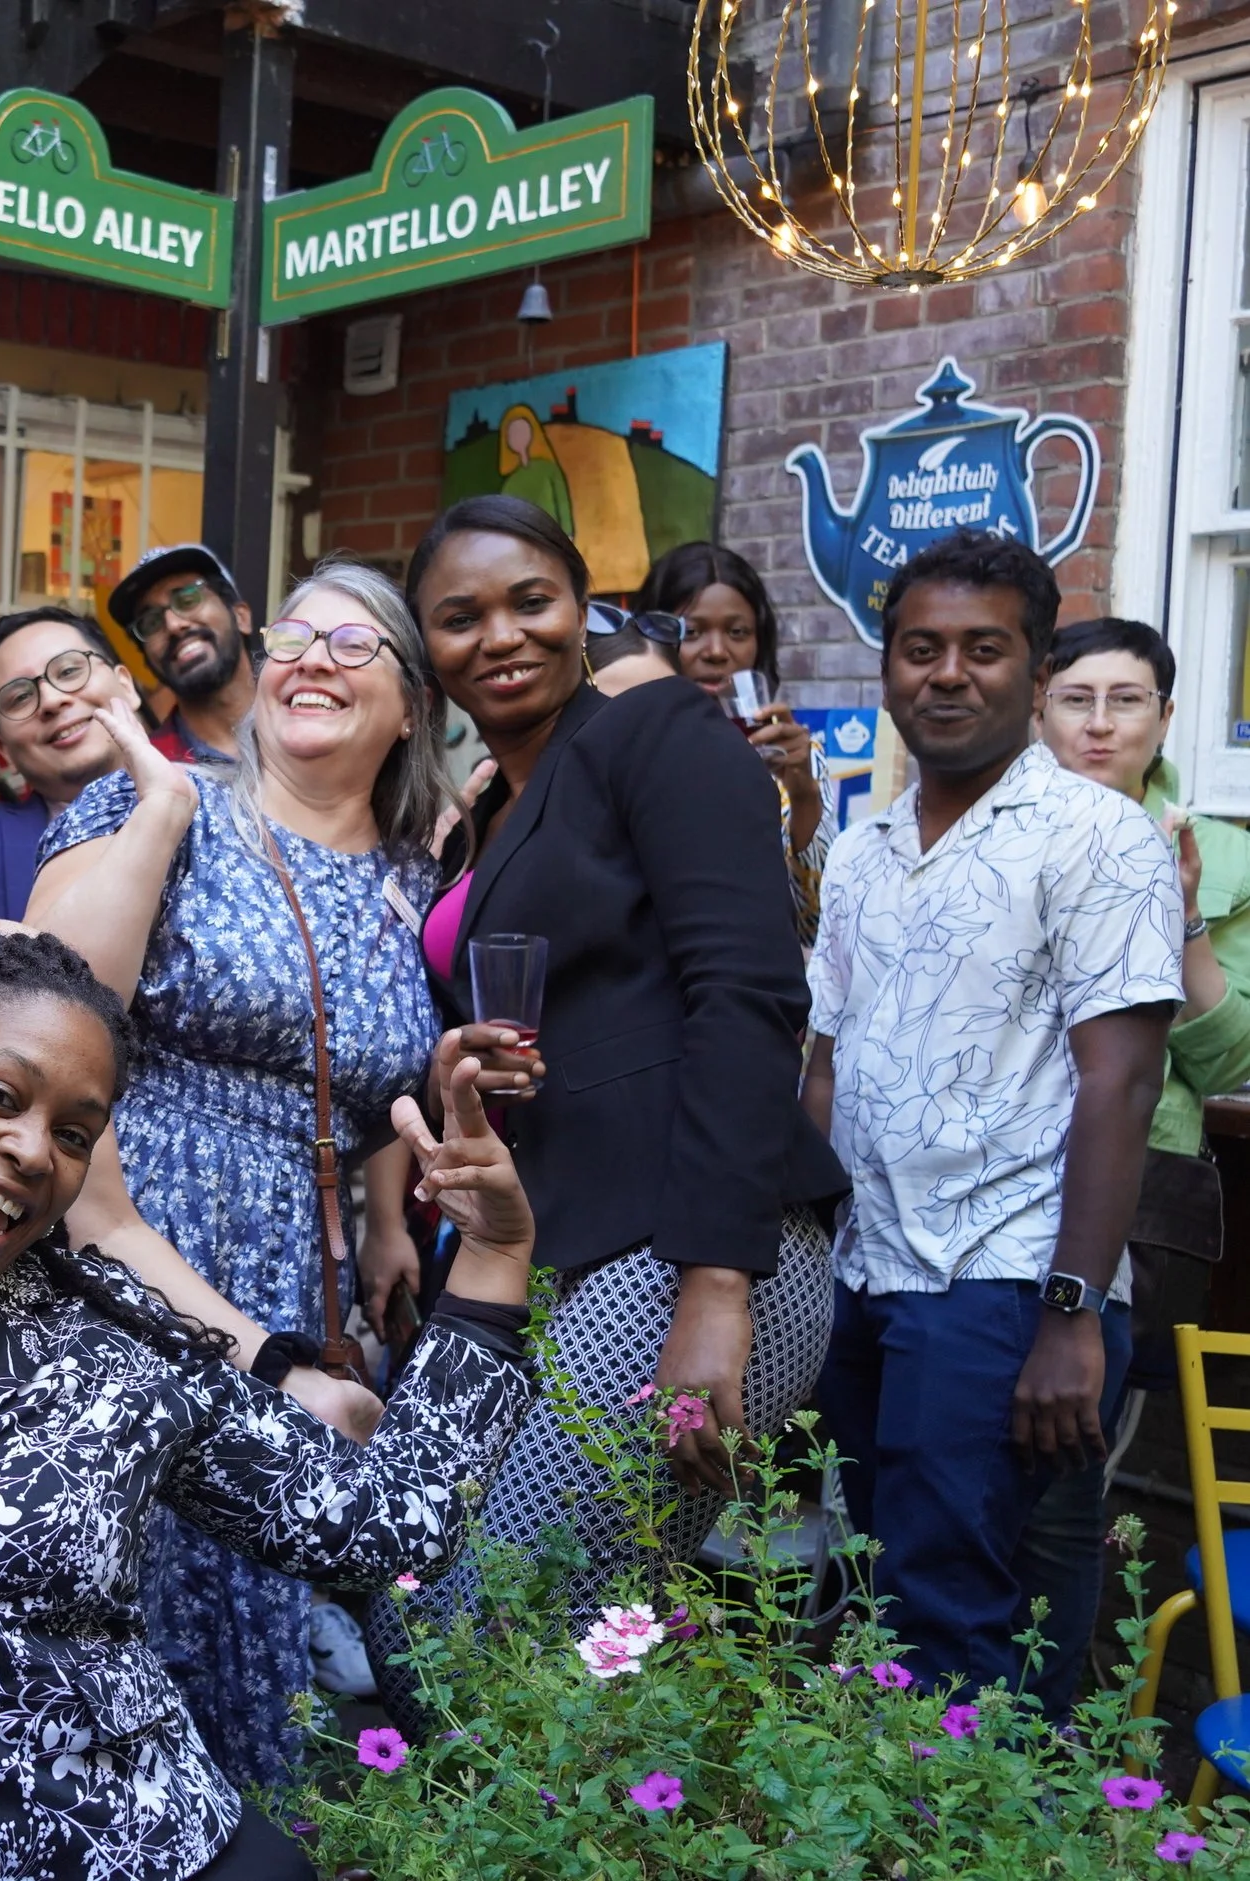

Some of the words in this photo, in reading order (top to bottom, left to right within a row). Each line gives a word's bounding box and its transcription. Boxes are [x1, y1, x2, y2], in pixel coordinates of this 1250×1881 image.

[93, 207, 206, 268] ALLEY
[285, 195, 478, 280] MARTELLO
[486, 157, 612, 231] ALLEY
[888, 462, 999, 500] Delightfully
[890, 492, 991, 530] Different
[860, 524, 908, 569] TEA
